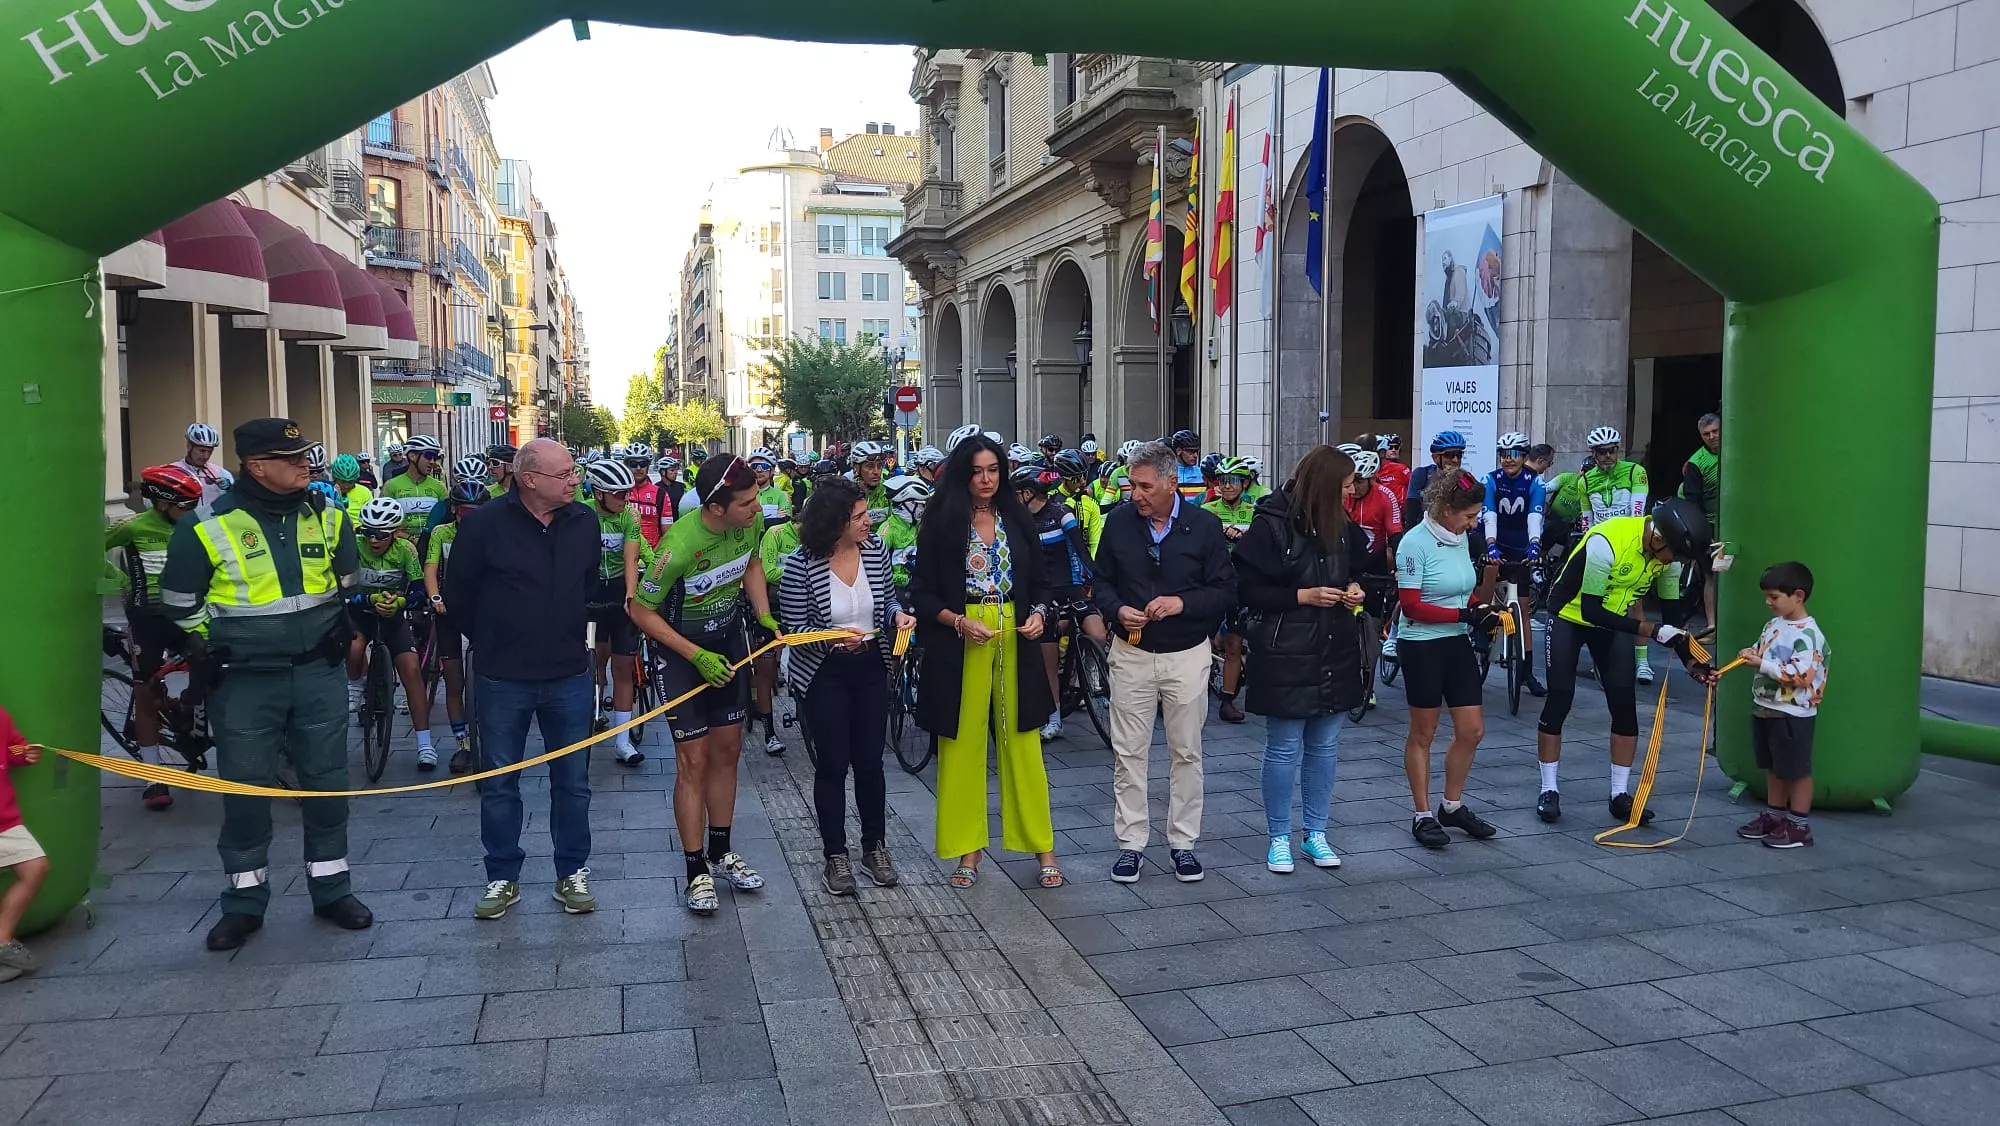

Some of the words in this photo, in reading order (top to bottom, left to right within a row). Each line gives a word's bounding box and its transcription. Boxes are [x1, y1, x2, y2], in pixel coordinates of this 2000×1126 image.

[137, 51, 207, 100] La
[1624, 0, 1835, 184] Huesca
[1636, 68, 1680, 114] La
[1445, 397, 1492, 414] UTÓPICOS
[1446, 381, 1477, 394] VIAJES
